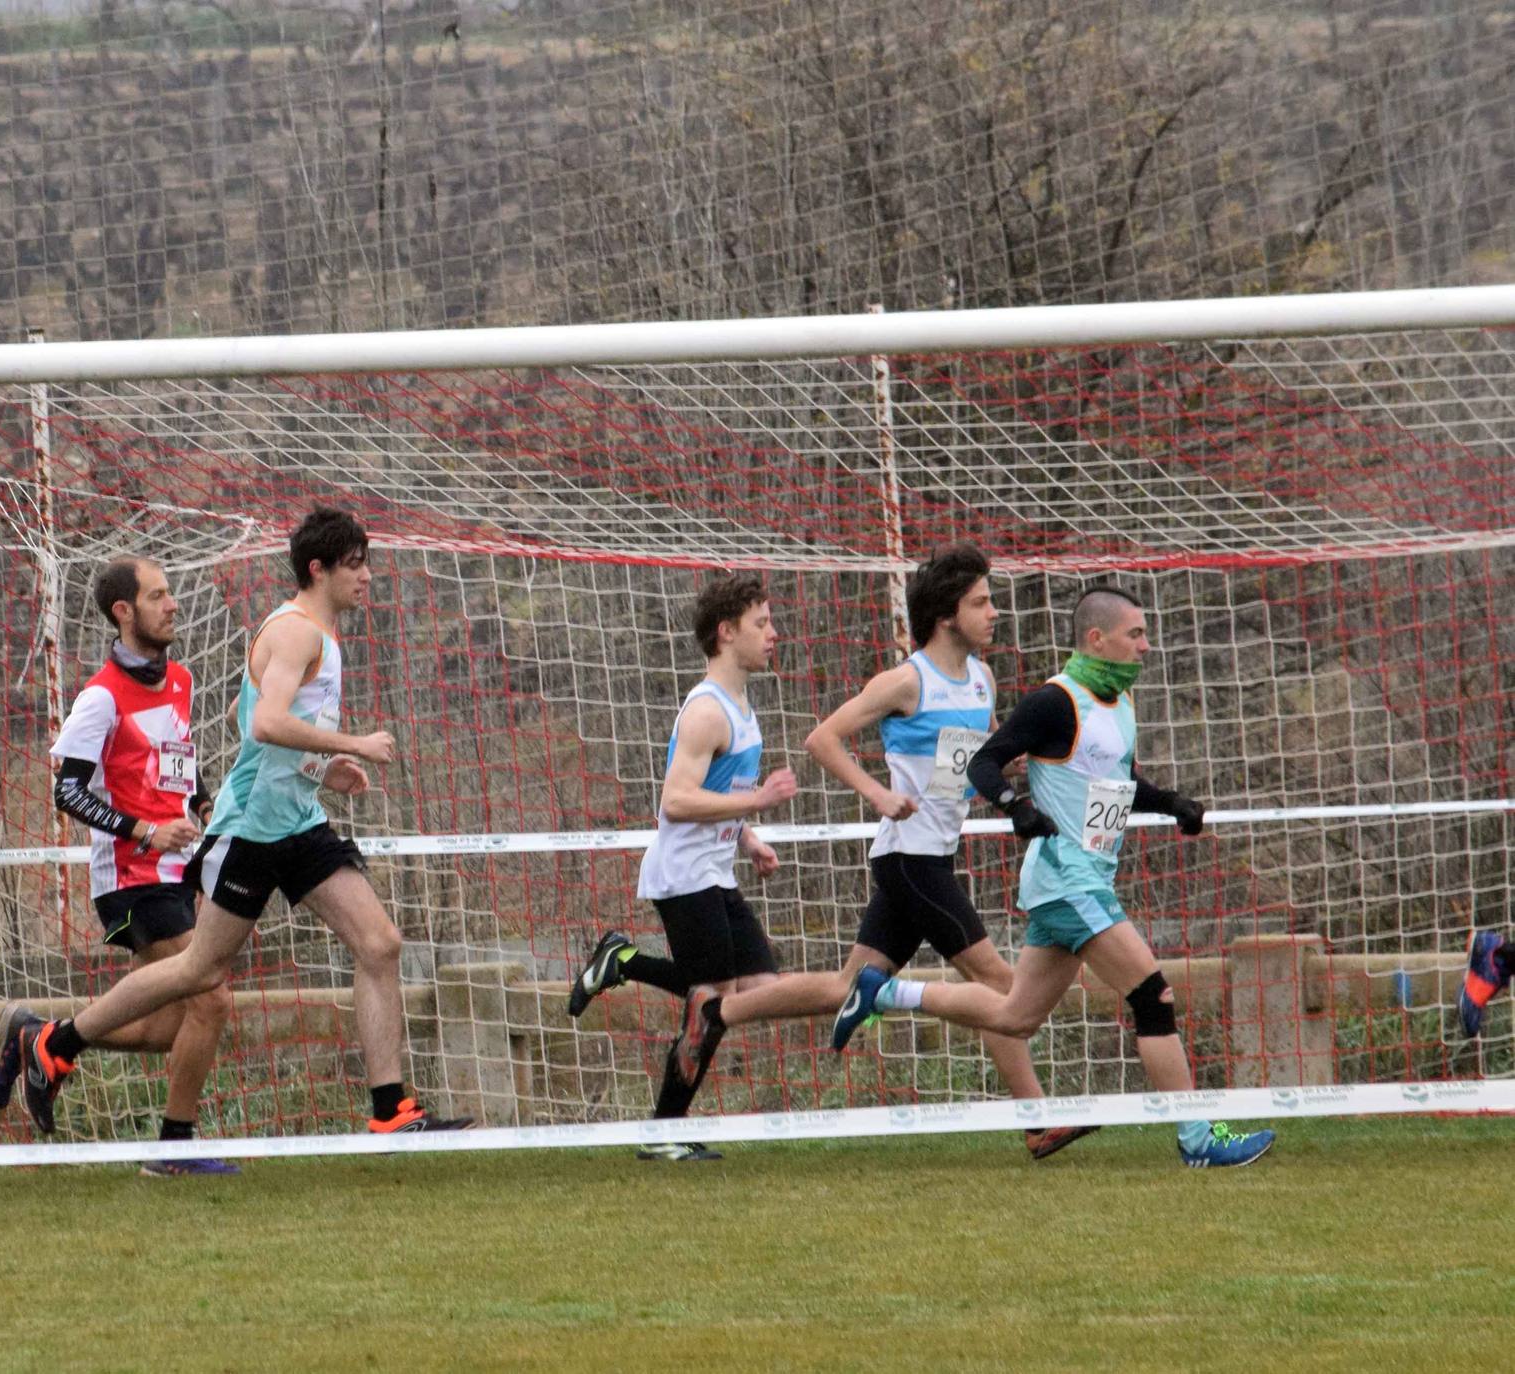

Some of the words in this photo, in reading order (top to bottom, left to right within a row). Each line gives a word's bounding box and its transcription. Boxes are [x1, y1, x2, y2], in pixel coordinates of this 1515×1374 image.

[172, 757, 184, 777] 19
[952, 748, 977, 776] 9
[1086, 801, 1131, 831] 205
